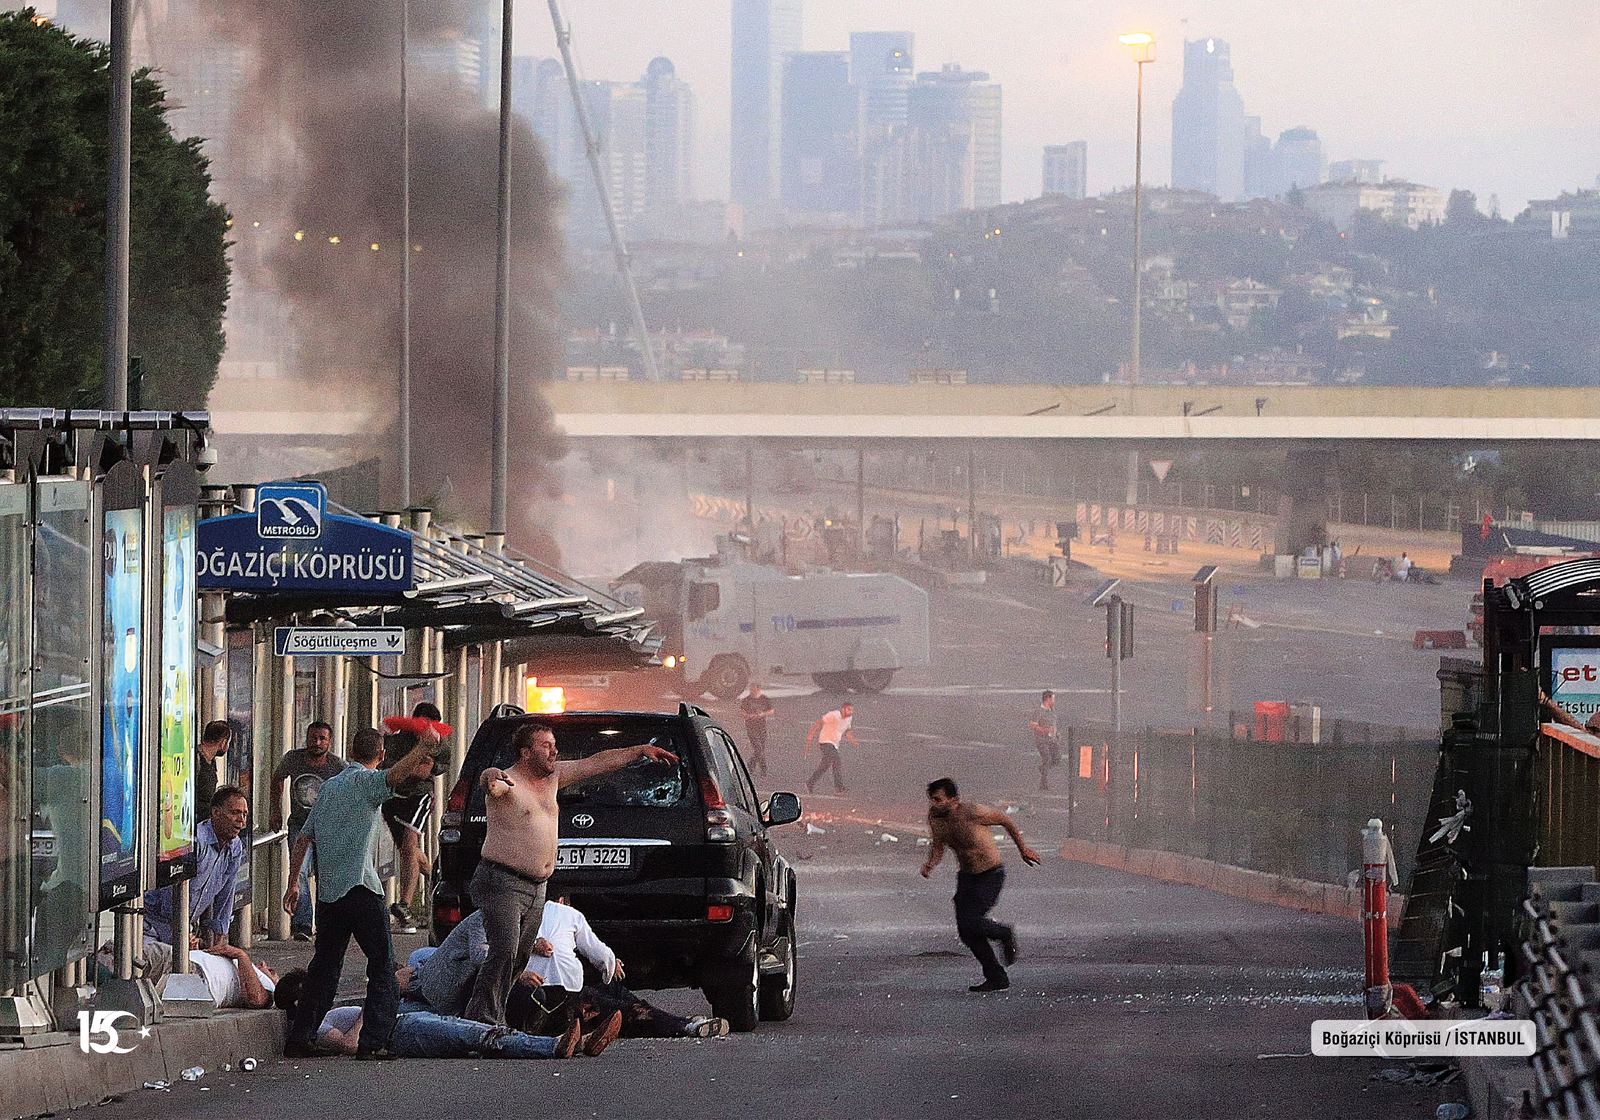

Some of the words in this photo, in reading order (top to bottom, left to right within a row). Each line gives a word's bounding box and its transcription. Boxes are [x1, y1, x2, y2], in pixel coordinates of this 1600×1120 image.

[262, 525, 316, 535] METROBÜS
[294, 546, 405, 581] KÖPRÜSÜ
[293, 635, 378, 650] Söğütlüçeşme
[570, 849, 586, 864] GV
[593, 849, 627, 864] 3229
